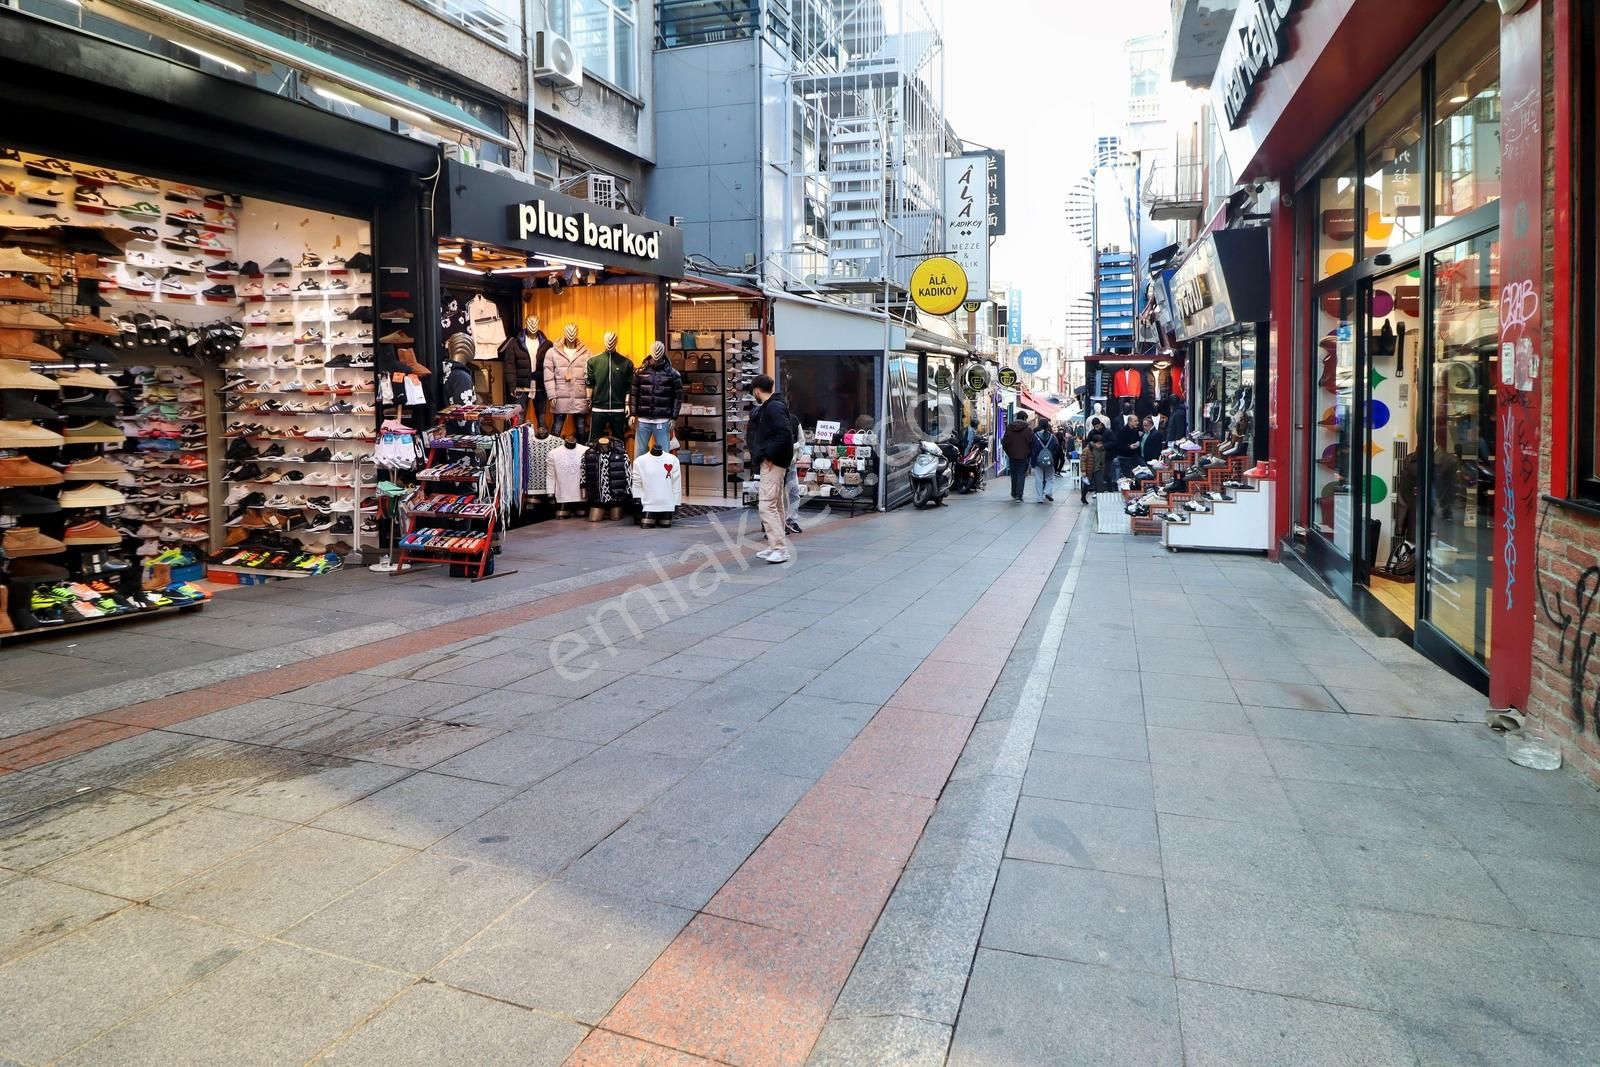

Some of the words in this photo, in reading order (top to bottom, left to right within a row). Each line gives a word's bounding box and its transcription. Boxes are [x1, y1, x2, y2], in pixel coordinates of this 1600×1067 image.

[519, 199, 580, 242] plus
[583, 211, 660, 260] barkod
[951, 242, 980, 250] MEZZE
[918, 284, 958, 297] KADIKÖY
